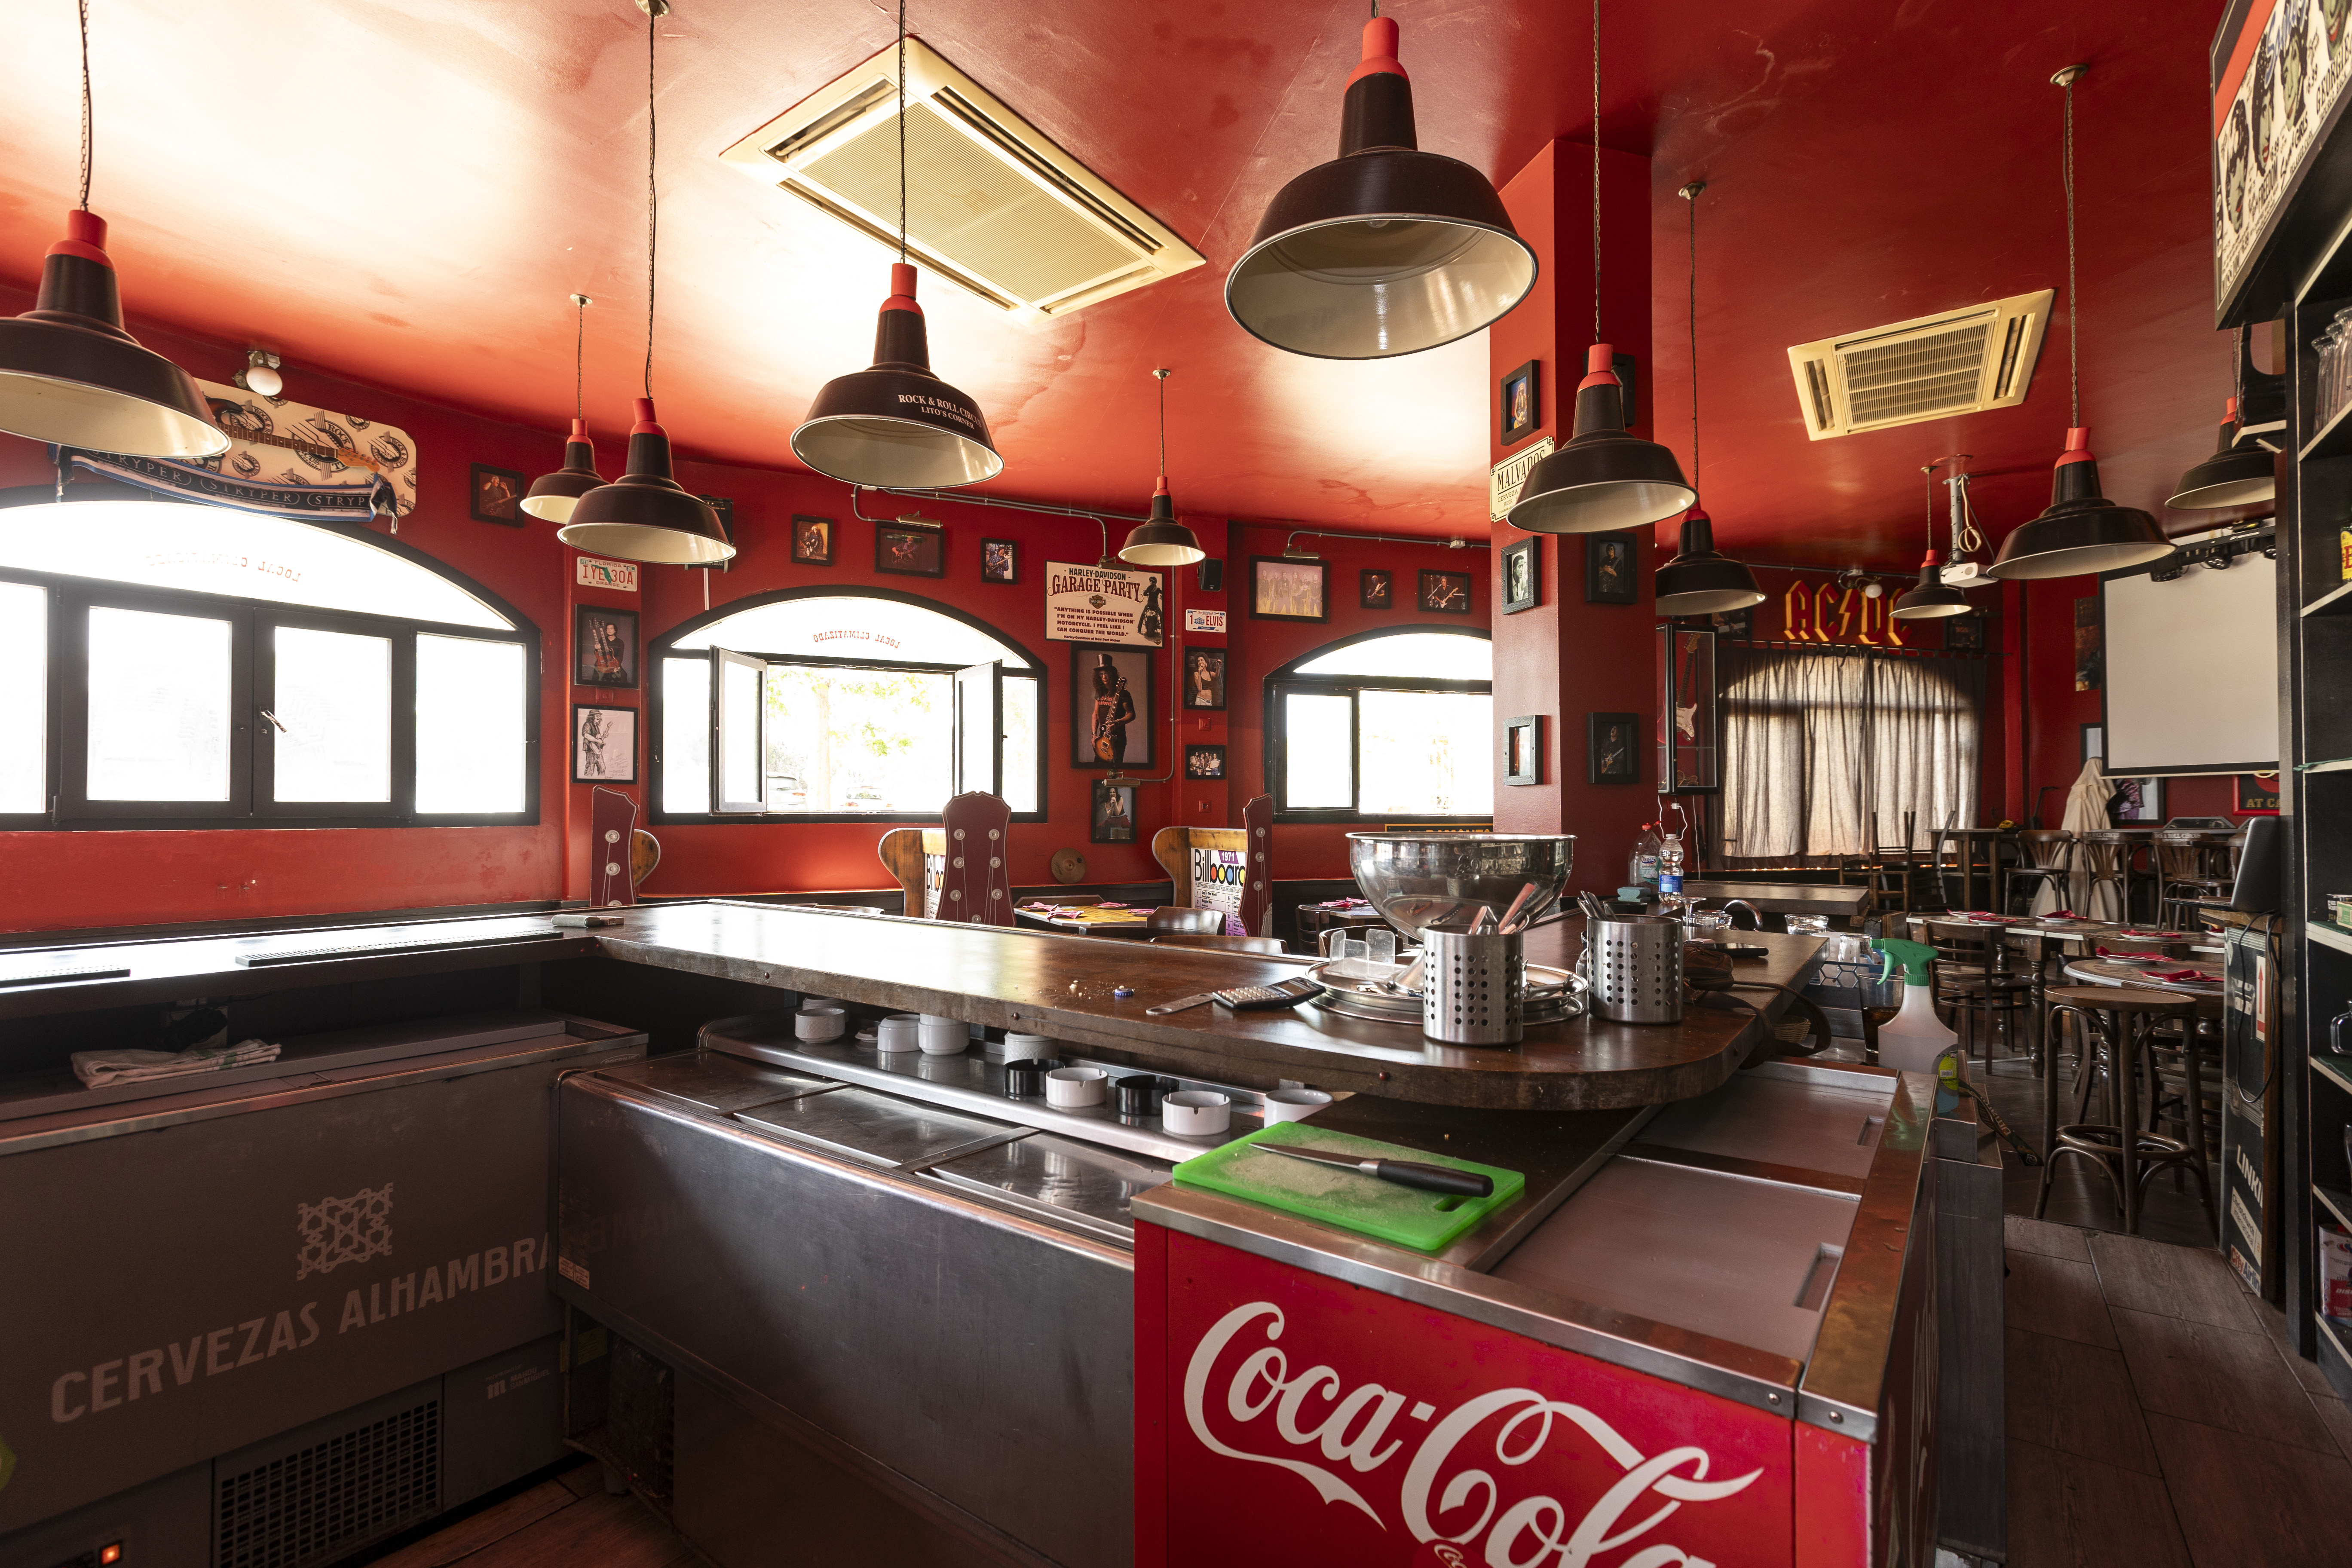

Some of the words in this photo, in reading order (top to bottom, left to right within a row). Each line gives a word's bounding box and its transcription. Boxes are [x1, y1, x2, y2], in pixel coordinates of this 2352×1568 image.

[898, 395, 927, 404] ROCK
[928, 397, 935, 406] &
[937, 398, 959, 413] ROLL
[960, 407, 982, 428] CIRCUS
[948, 413, 974, 429] CORNER
[327, 423, 351, 445] ROCK
[209, 481, 291, 502] STRYPER
[1498, 489, 1518, 503] CERVEZA
[1504, 499, 1513, 507] BEER
[1069, 567, 1126, 581] HARLEY-DAVIDSON
[1047, 574, 1100, 597] GARAGE
[1102, 578, 1144, 603] PARTY
[1190, 615, 1193, 625] 1
[1206, 615, 1223, 627] ELVIS
[2246, 798, 2263, 808] AT
[1221, 851, 1234, 861] 1971
[51, 1302, 321, 1424] CERVEZAS
[339, 1233, 549, 1335] ALHAMBRA
[510, 1366, 537, 1382] MAHOU
